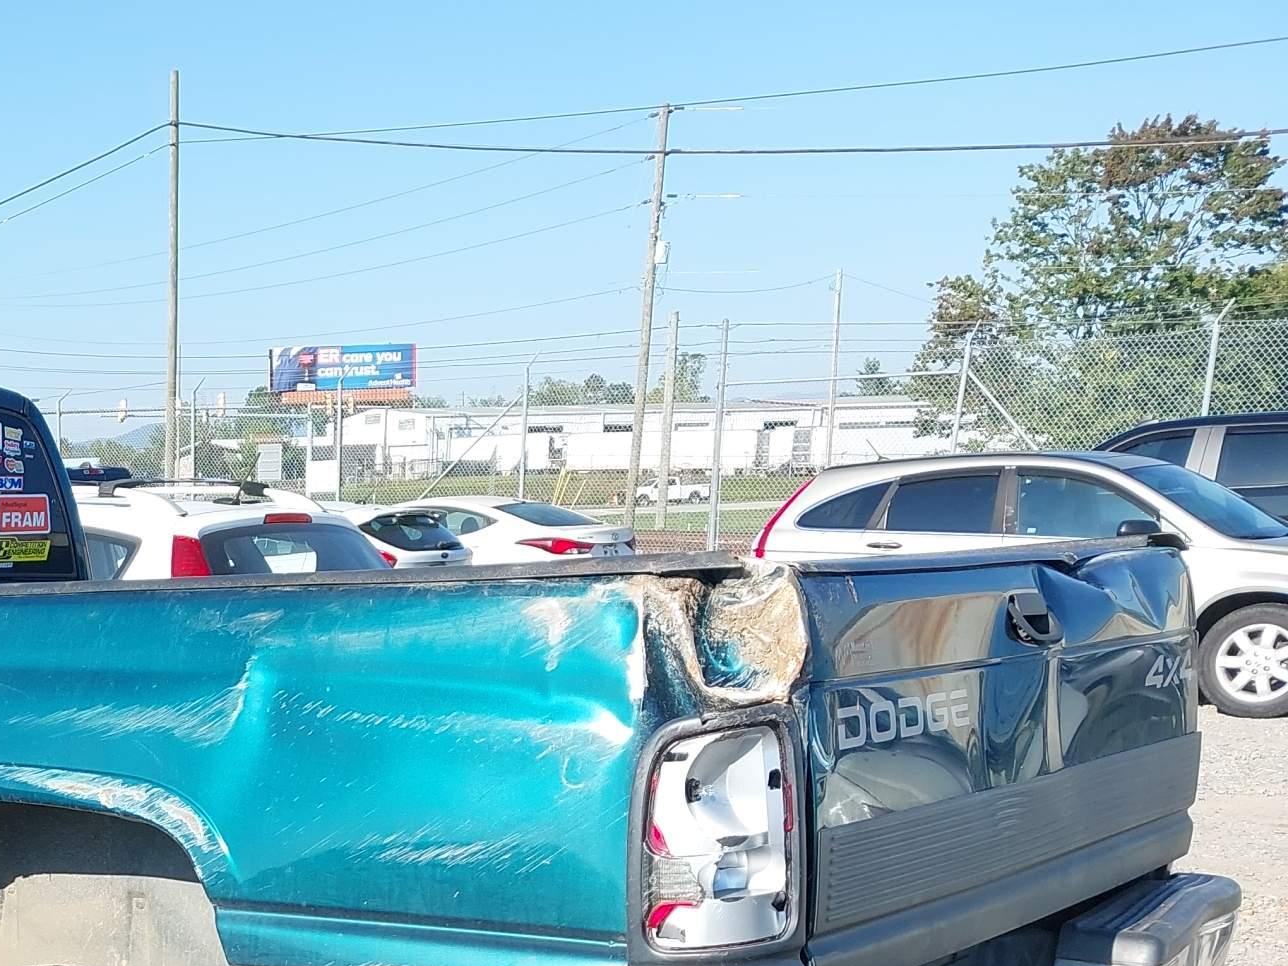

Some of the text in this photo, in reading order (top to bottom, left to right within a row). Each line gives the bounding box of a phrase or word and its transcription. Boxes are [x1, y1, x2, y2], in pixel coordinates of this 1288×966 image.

[318, 350, 402, 364] ER care you
[317, 366, 342, 377] can
[2, 511, 45, 528] FRAM
[837, 689, 971, 750] DODGE
